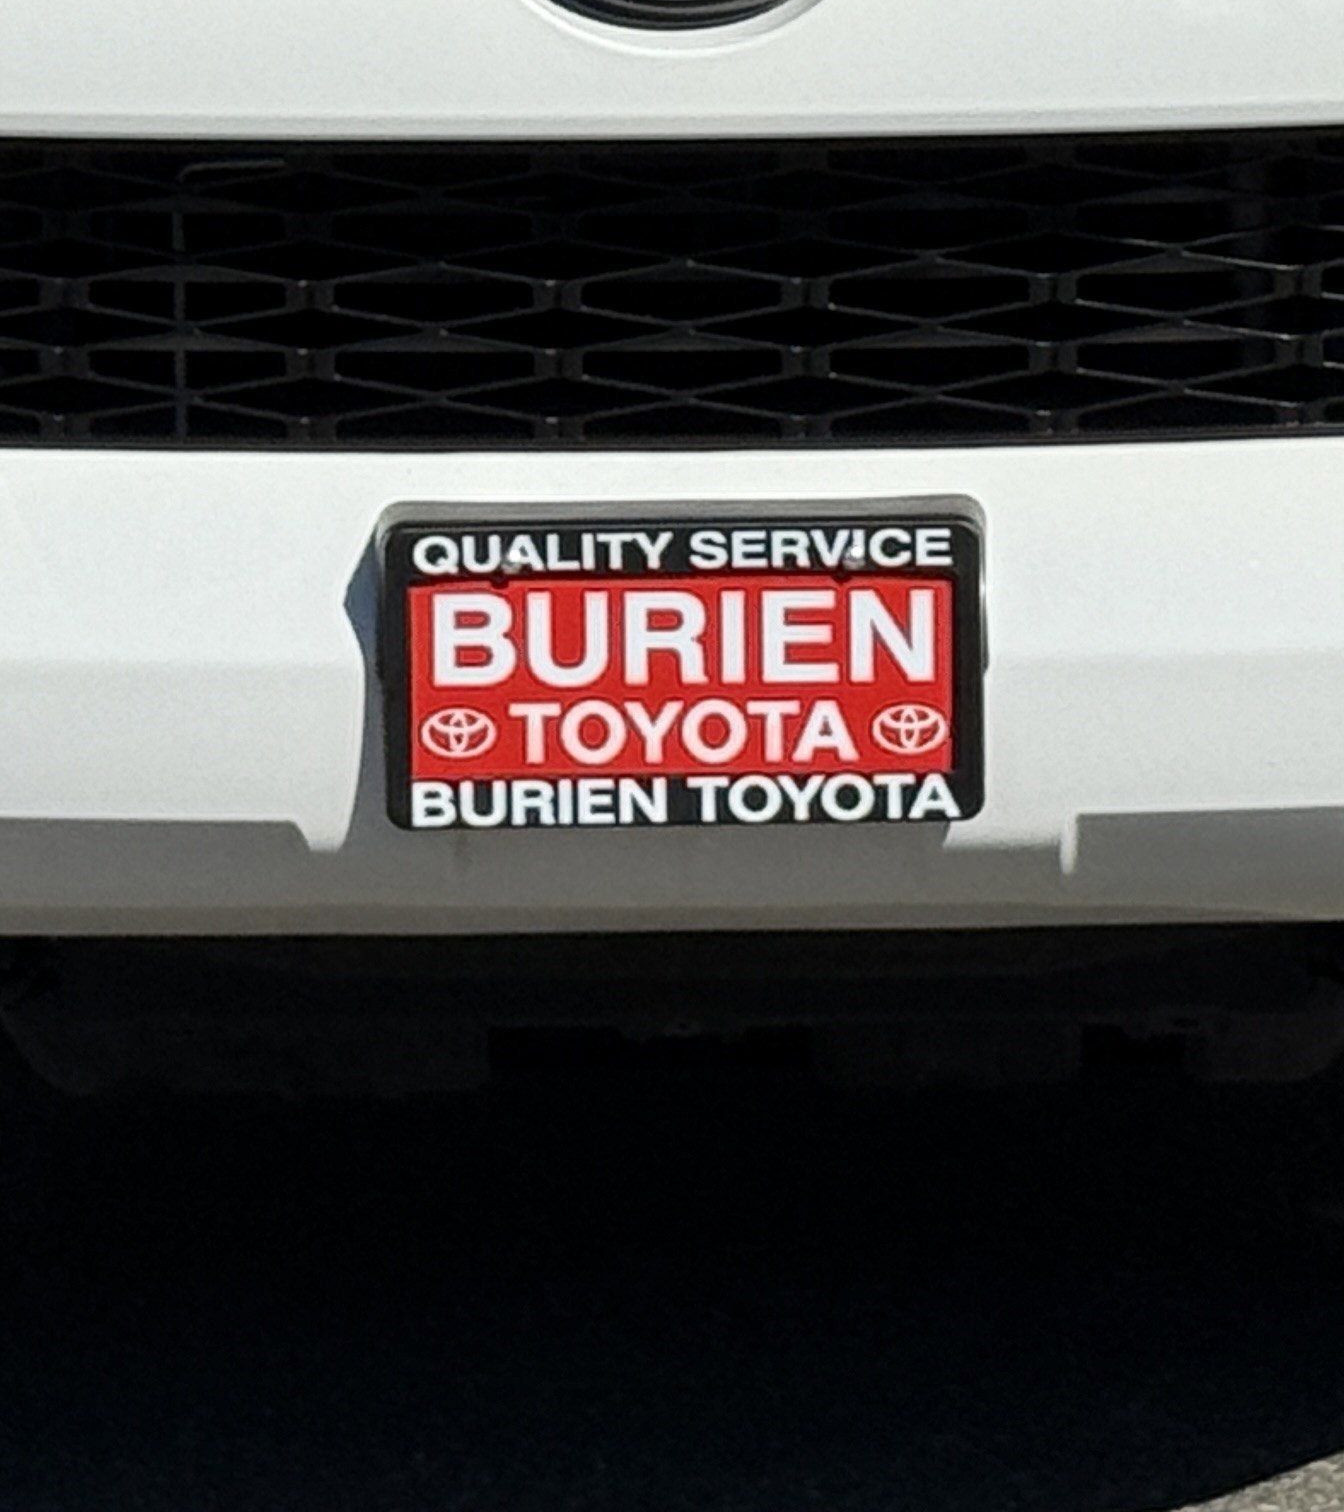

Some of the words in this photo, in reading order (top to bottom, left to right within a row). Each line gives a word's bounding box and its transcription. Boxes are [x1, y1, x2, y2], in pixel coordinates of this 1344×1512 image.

[412, 532, 673, 574] QUALITY
[688, 528, 953, 571] SERVICE
[431, 589, 936, 687] BURIEN
[508, 698, 859, 766] TOYOTA
[412, 778, 668, 828] BURIEN
[687, 774, 960, 824] TOYOTA
